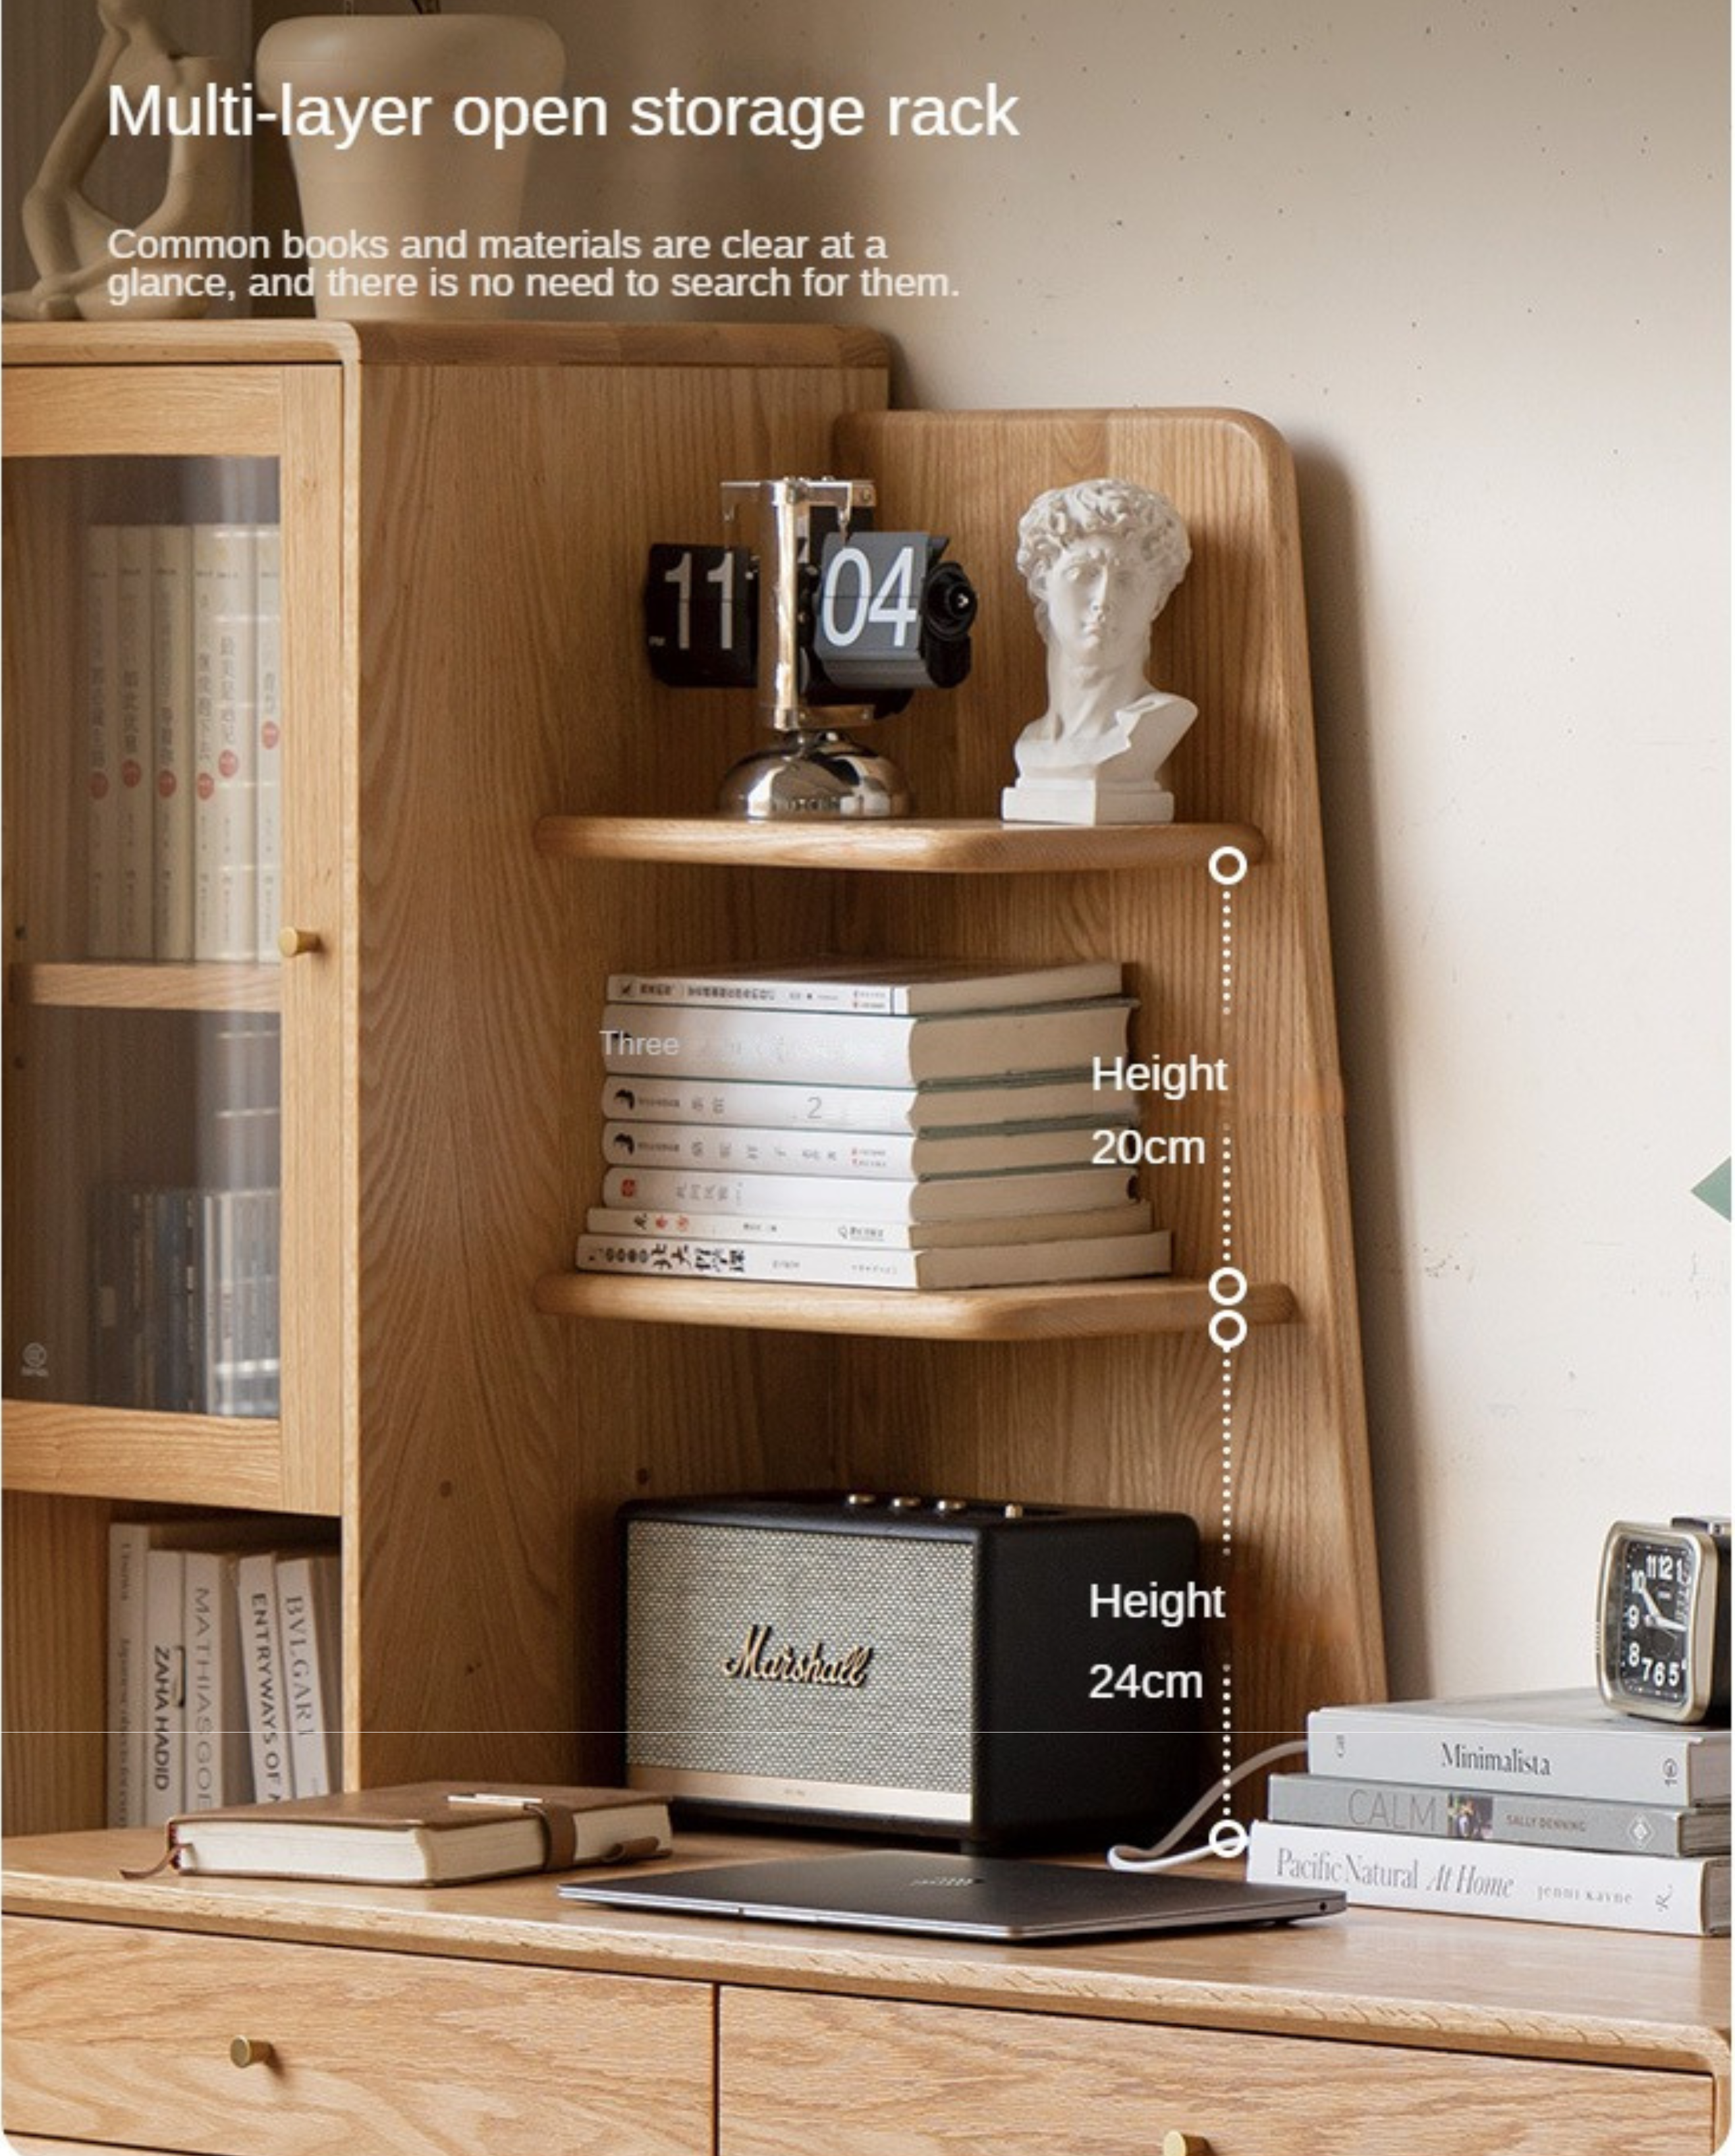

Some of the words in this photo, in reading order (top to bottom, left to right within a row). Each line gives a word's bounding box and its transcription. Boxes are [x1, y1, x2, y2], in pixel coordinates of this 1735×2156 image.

[665, 551, 734, 650] 11
[823, 546, 918, 647] 04
[1658, 1554, 1673, 1580] 12
[196, 1587, 211, 1735] MATHIAS
[286, 1595, 314, 1736] BVLGARI
[724, 1624, 873, 1688] Marshall
[1628, 1642, 1640, 1667] 8
[1641, 1657, 1653, 1682] 7
[1653, 1661, 1665, 1687] 6
[1668, 1661, 1680, 1687] 5
[154, 1646, 170, 1712] ZAHA
[251, 1592, 279, 1745] ENTRYWAYS
[265, 1751, 281, 1786] OF
[153, 1716, 171, 1791] HADID
[1442, 1742, 1551, 1776] Minimalista
[1348, 1789, 1437, 1833] CALM
[1506, 1815, 1537, 1828] SALLY
[1277, 1847, 1342, 1883] Pacific
[1345, 1853, 1419, 1889] Natural
[1425, 1864, 1453, 1892] At
[1455, 1864, 1515, 1899] Home
